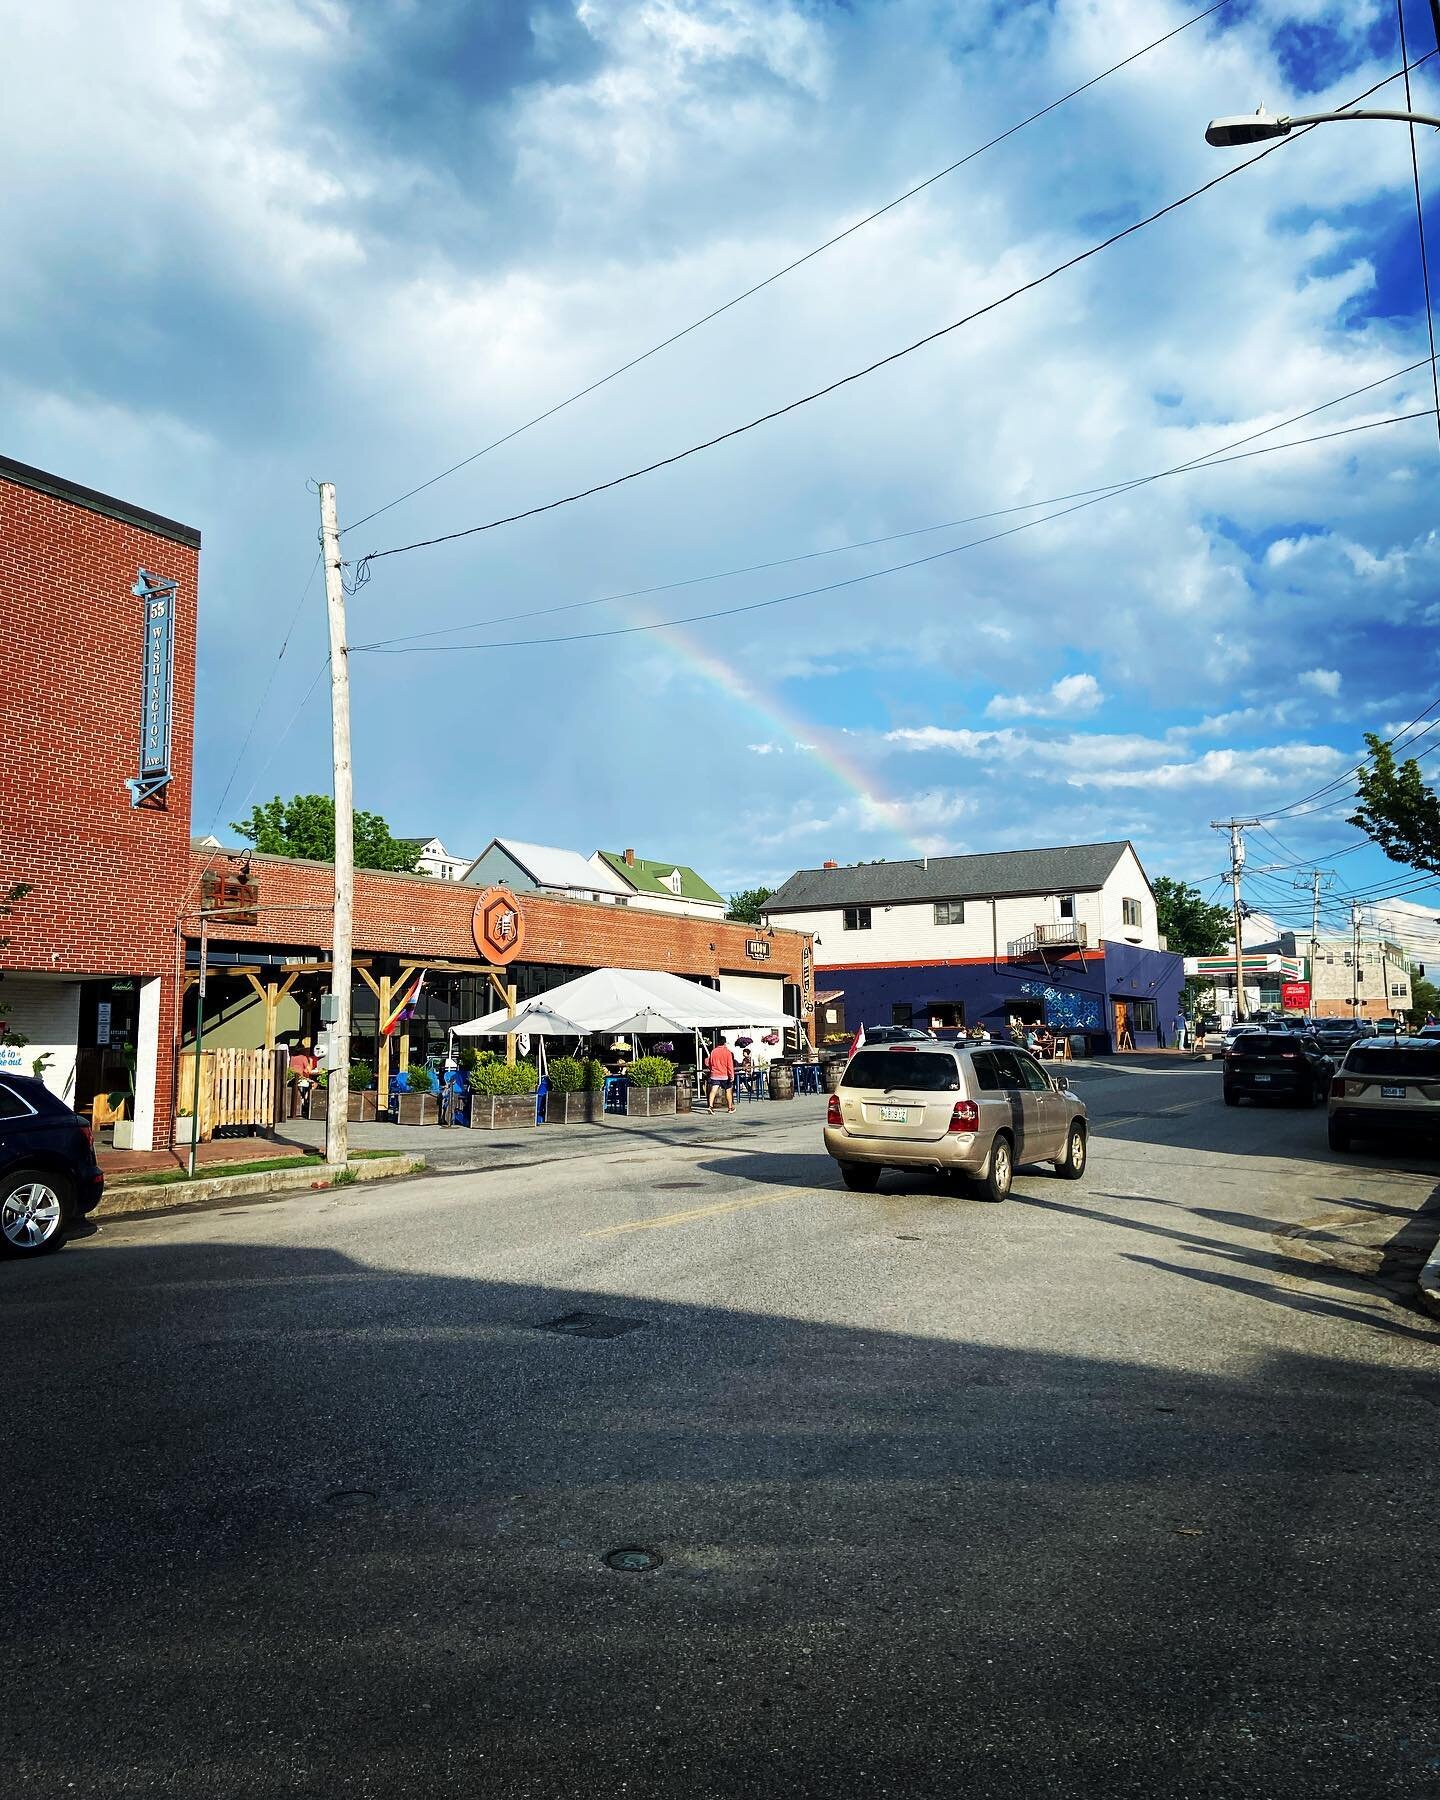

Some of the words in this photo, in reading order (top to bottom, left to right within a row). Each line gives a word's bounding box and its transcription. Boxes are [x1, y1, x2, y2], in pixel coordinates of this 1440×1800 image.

[150, 601, 165, 619] 55
[150, 626, 163, 749] WASHINGTON
[8, 1057, 22, 1066] out
